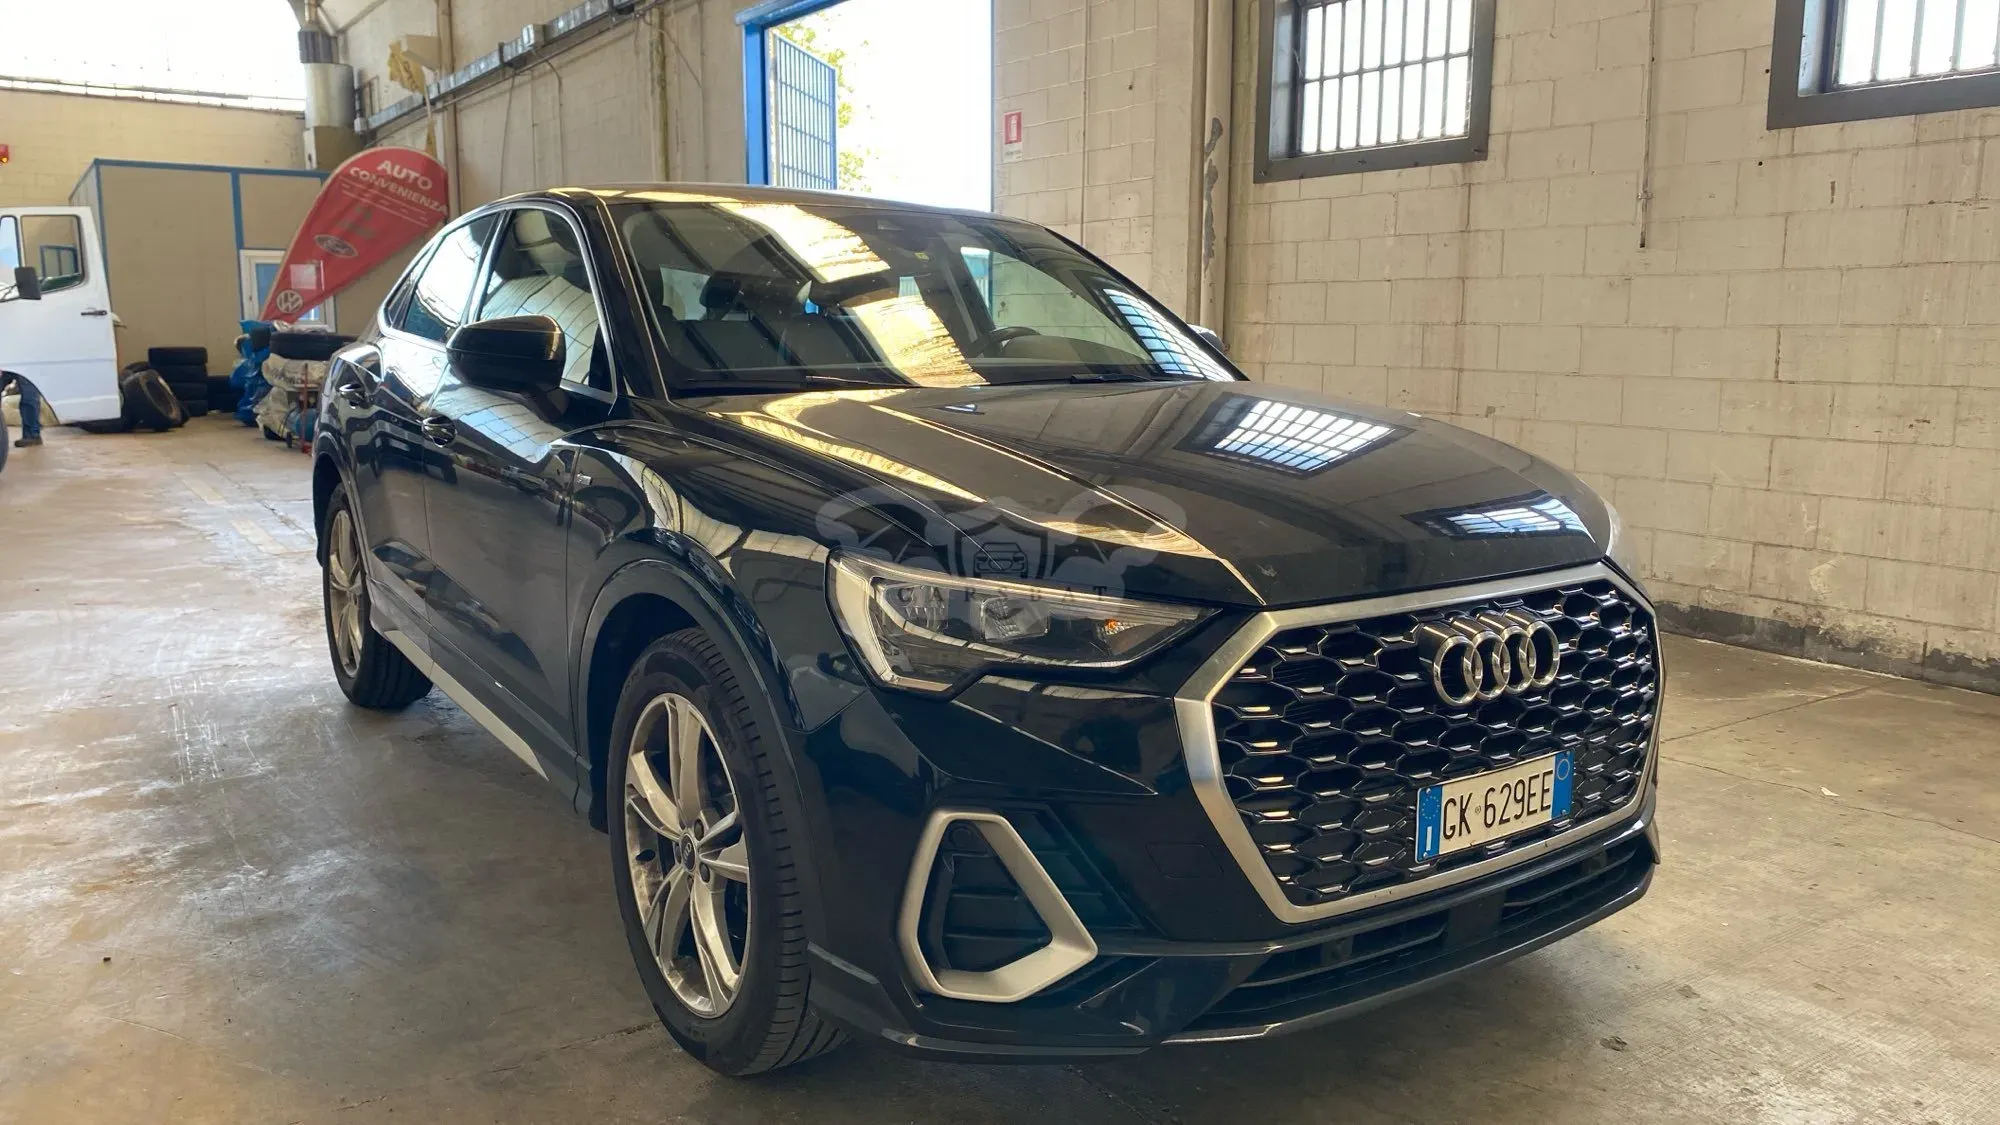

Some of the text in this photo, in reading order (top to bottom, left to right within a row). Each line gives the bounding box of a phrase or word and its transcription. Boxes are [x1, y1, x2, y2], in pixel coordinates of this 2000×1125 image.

[349, 166, 448, 215] CONVENIENZA
[377, 161, 432, 190] AUTO
[1443, 771, 1553, 839] GK 629EE
